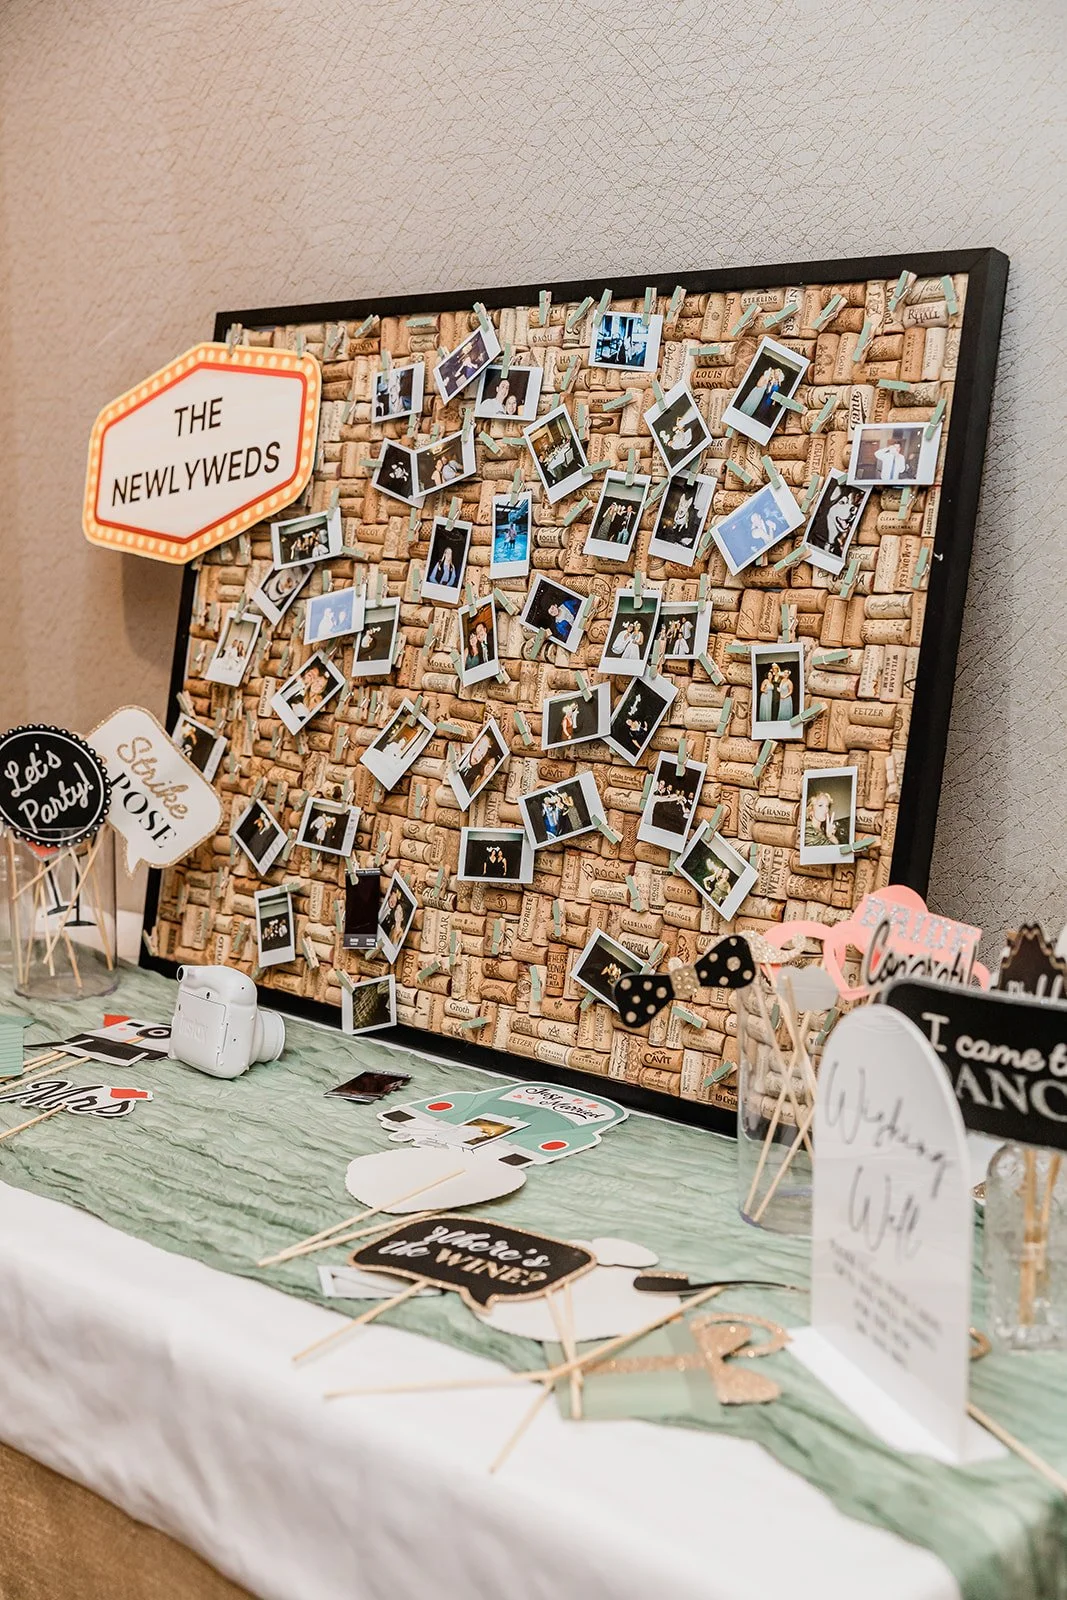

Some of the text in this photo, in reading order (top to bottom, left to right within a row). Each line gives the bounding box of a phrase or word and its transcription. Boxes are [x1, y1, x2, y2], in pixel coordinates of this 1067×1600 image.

[560, 354, 583, 364] HAN
[695, 371, 723, 379] LOUIS
[174, 397, 223, 437] THE
[112, 441, 281, 507] NEWLYWEDS
[889, 655, 898, 693] WILLIAMS
[853, 707, 884, 717] FETZER
[4, 743, 62, 798] Let's
[116, 736, 189, 820] Strike
[540, 766, 564, 778] CAVIT
[18, 761, 95, 834] Party!
[107, 772, 177, 848] POSE
[766, 809, 791, 818] HANDS
[594, 867, 626, 879] ROCAS
[603, 859, 621, 868] LAS
[767, 847, 784, 896] WENTE
[622, 919, 653, 930] GABBIANO
[664, 909, 692, 921] BERINGER
[859, 895, 979, 957] BRIDE
[438, 914, 450, 954] ROBLAR
[621, 941, 650, 956] COPPOLA
[402, 953, 414, 985] RECAS
[449, 1002, 470, 1014] Groth
[508, 1036, 532, 1048] FETZER
[921, 1011, 950, 1053] I
[955, 1034, 1046, 1072] came
[644, 1053, 672, 1065] CAVIT
[0, 1080, 132, 1115] Mrs
[525, 1087, 564, 1101] Just
[538, 1100, 606, 1120] Married
[849, 1165, 922, 1262] Well
[424, 1225, 552, 1268] Where's
[378, 1239, 548, 1287] the WINE?
